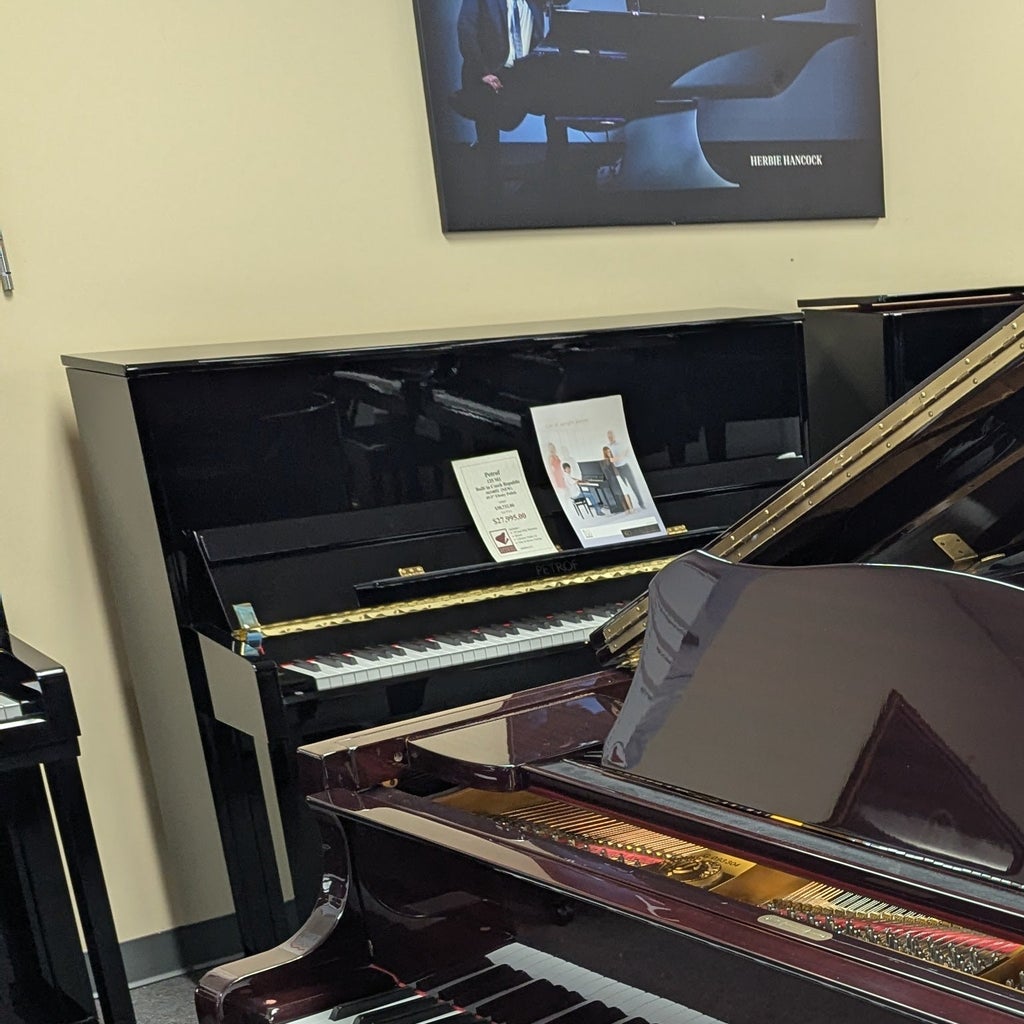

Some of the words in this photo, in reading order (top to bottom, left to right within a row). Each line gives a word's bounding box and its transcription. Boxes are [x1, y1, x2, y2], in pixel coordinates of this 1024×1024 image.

[750, 155, 782, 167] HERBIE
[783, 154, 823, 166] HANCOCK
[484, 470, 501, 479] Petrof
[493, 513, 527, 525] $27,995.00
[535, 559, 577, 576] PETROF
